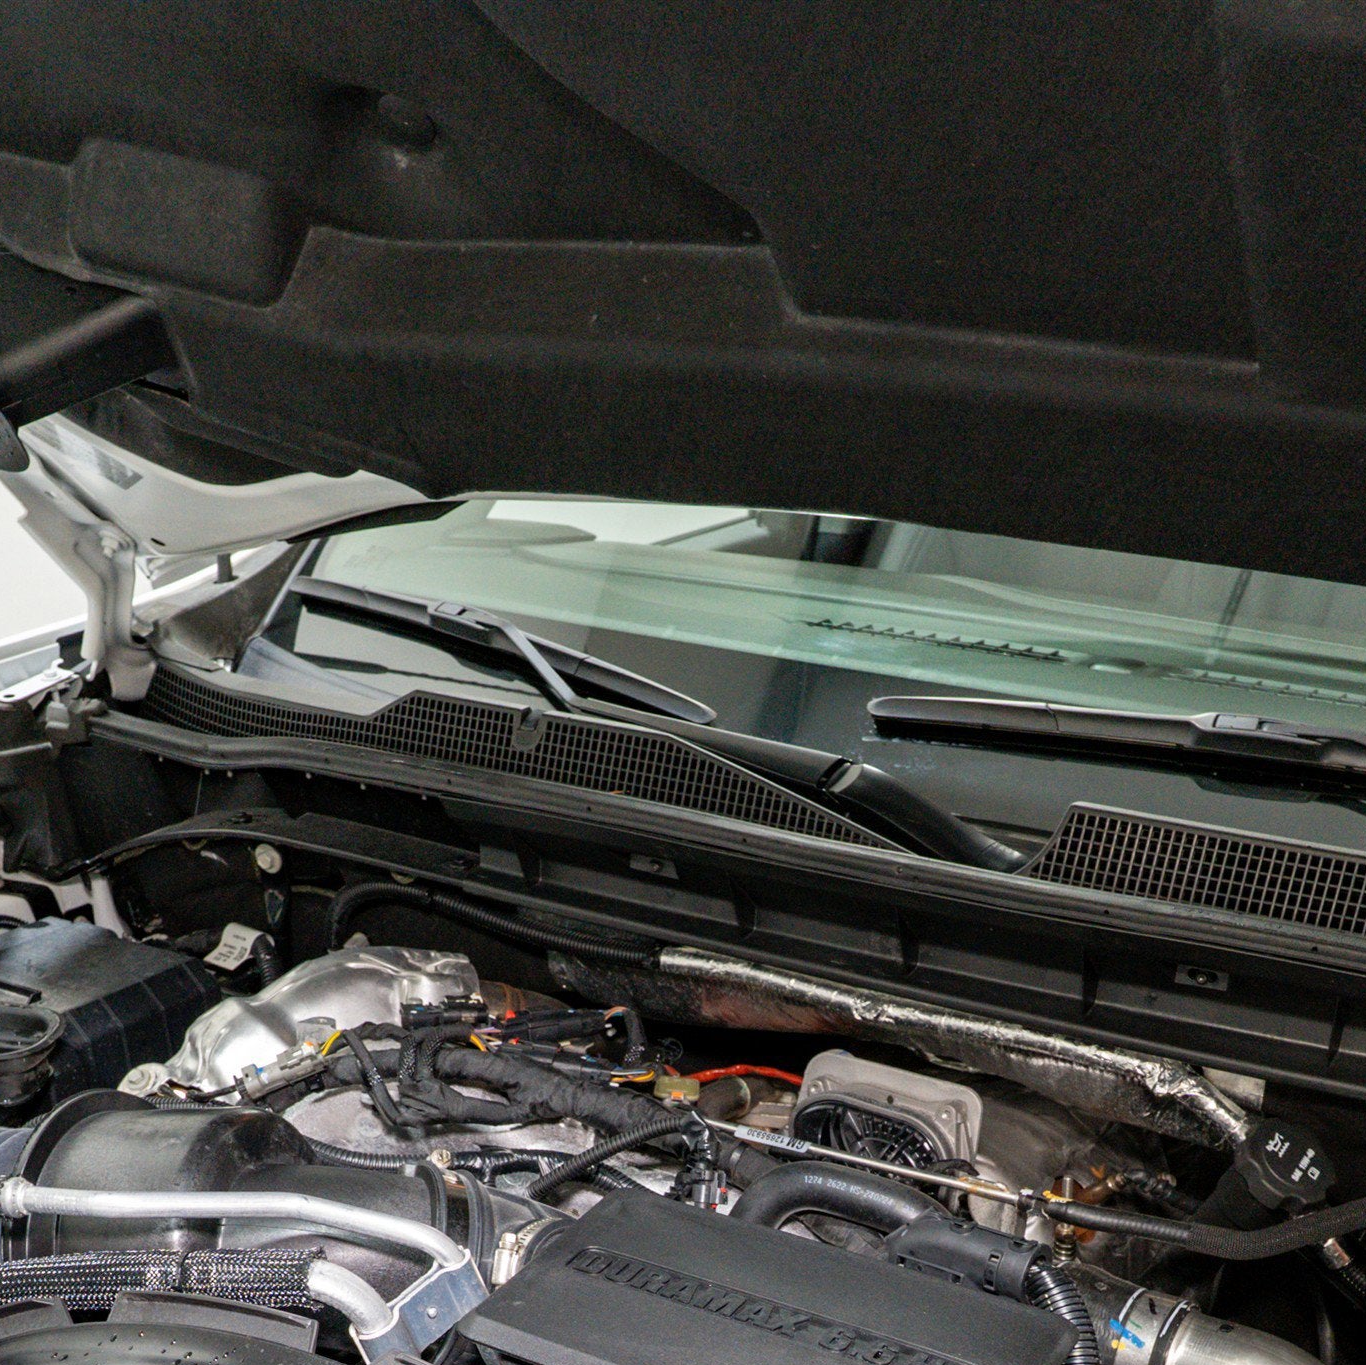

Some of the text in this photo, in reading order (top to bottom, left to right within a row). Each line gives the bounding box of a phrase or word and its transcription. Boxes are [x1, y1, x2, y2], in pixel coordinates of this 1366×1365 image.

[785, 1137, 806, 1150] GM
[826, 1178, 847, 1191] 2622
[571, 1249, 812, 1338] DURAMAX
